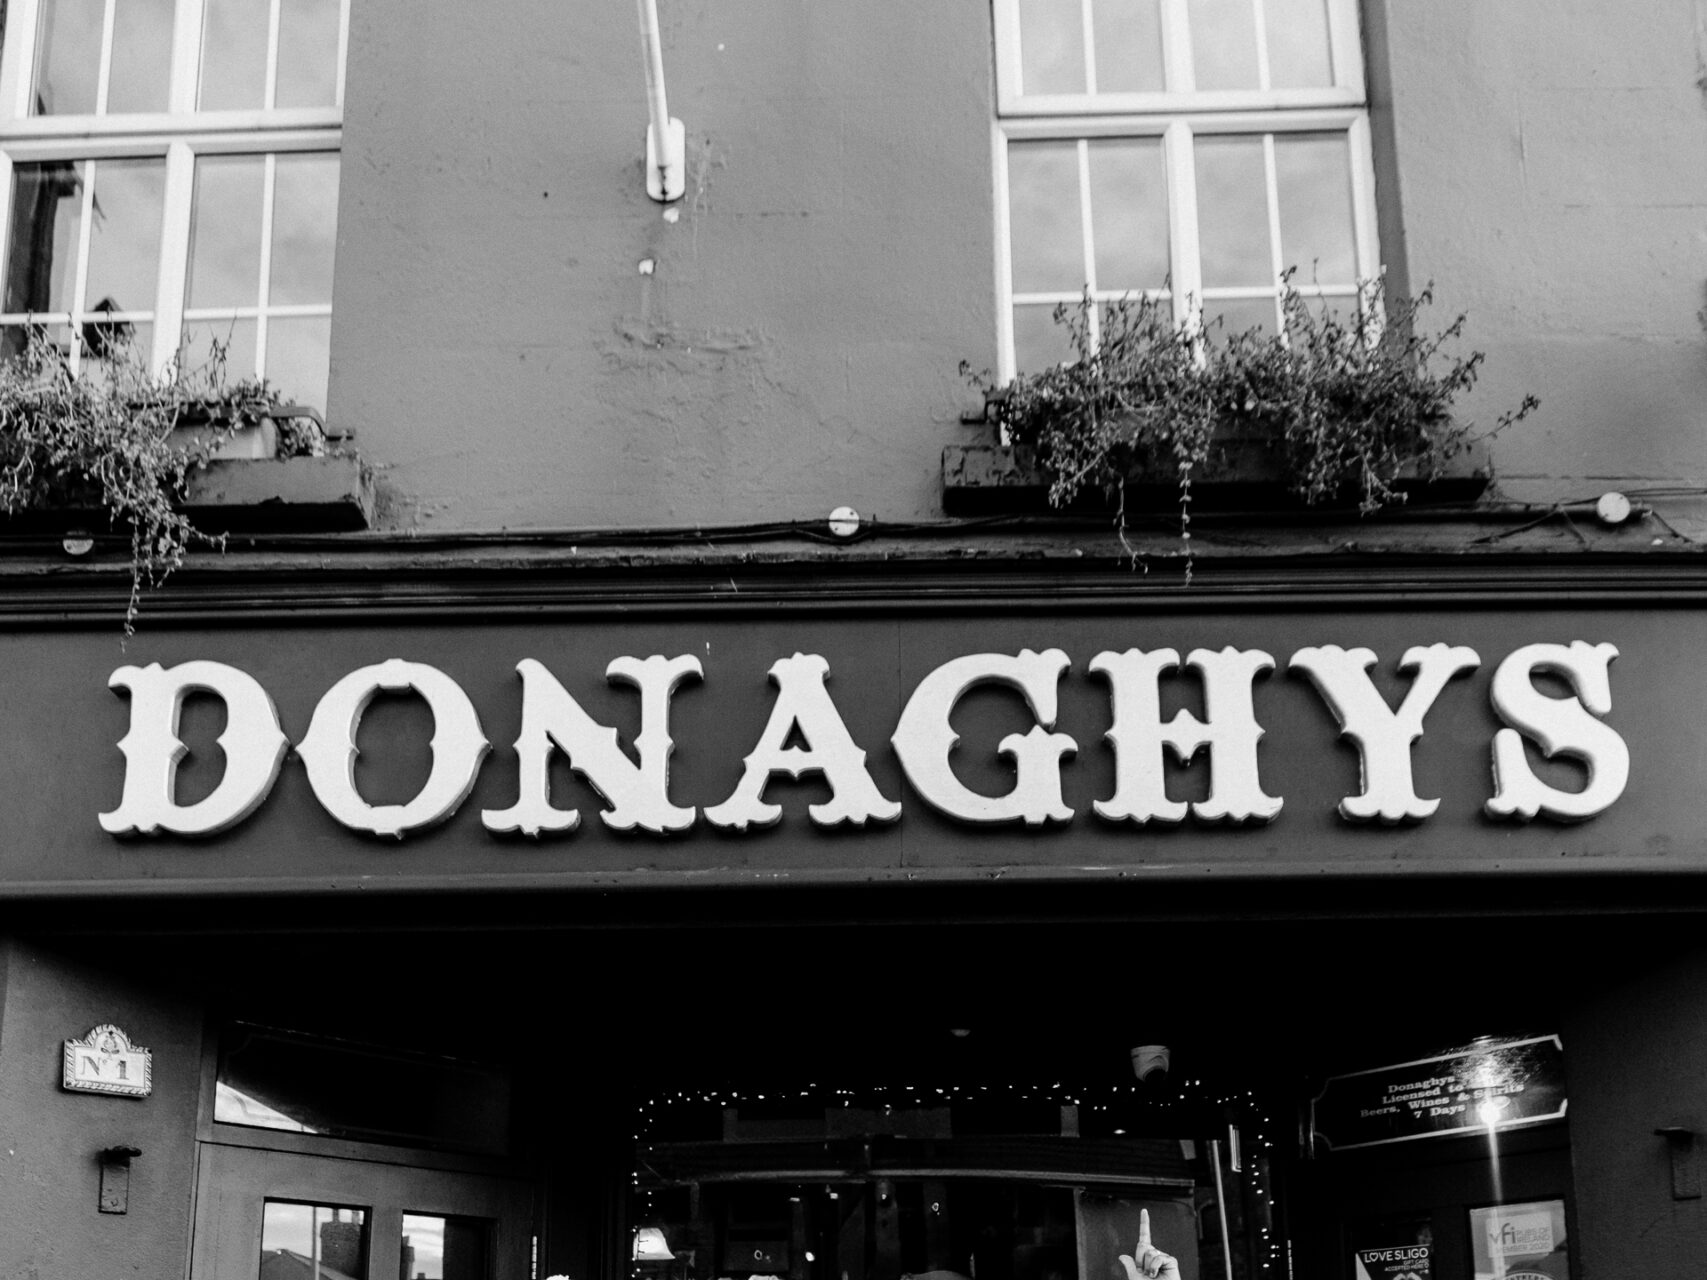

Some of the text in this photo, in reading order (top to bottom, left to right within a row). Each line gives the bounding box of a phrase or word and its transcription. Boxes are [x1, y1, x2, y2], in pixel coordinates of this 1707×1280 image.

[97, 640, 1630, 839] DONAGHYS
[116, 1060, 130, 1081] 1
[1382, 1084, 1465, 1105] Licensed to
[1387, 1075, 1456, 1094] Donaghys
[1360, 1083, 1526, 1118] Beers, Wines & Sirits
[1413, 1104, 1467, 1119] 7 Days
[1394, 1247, 1429, 1260] SLIGO
